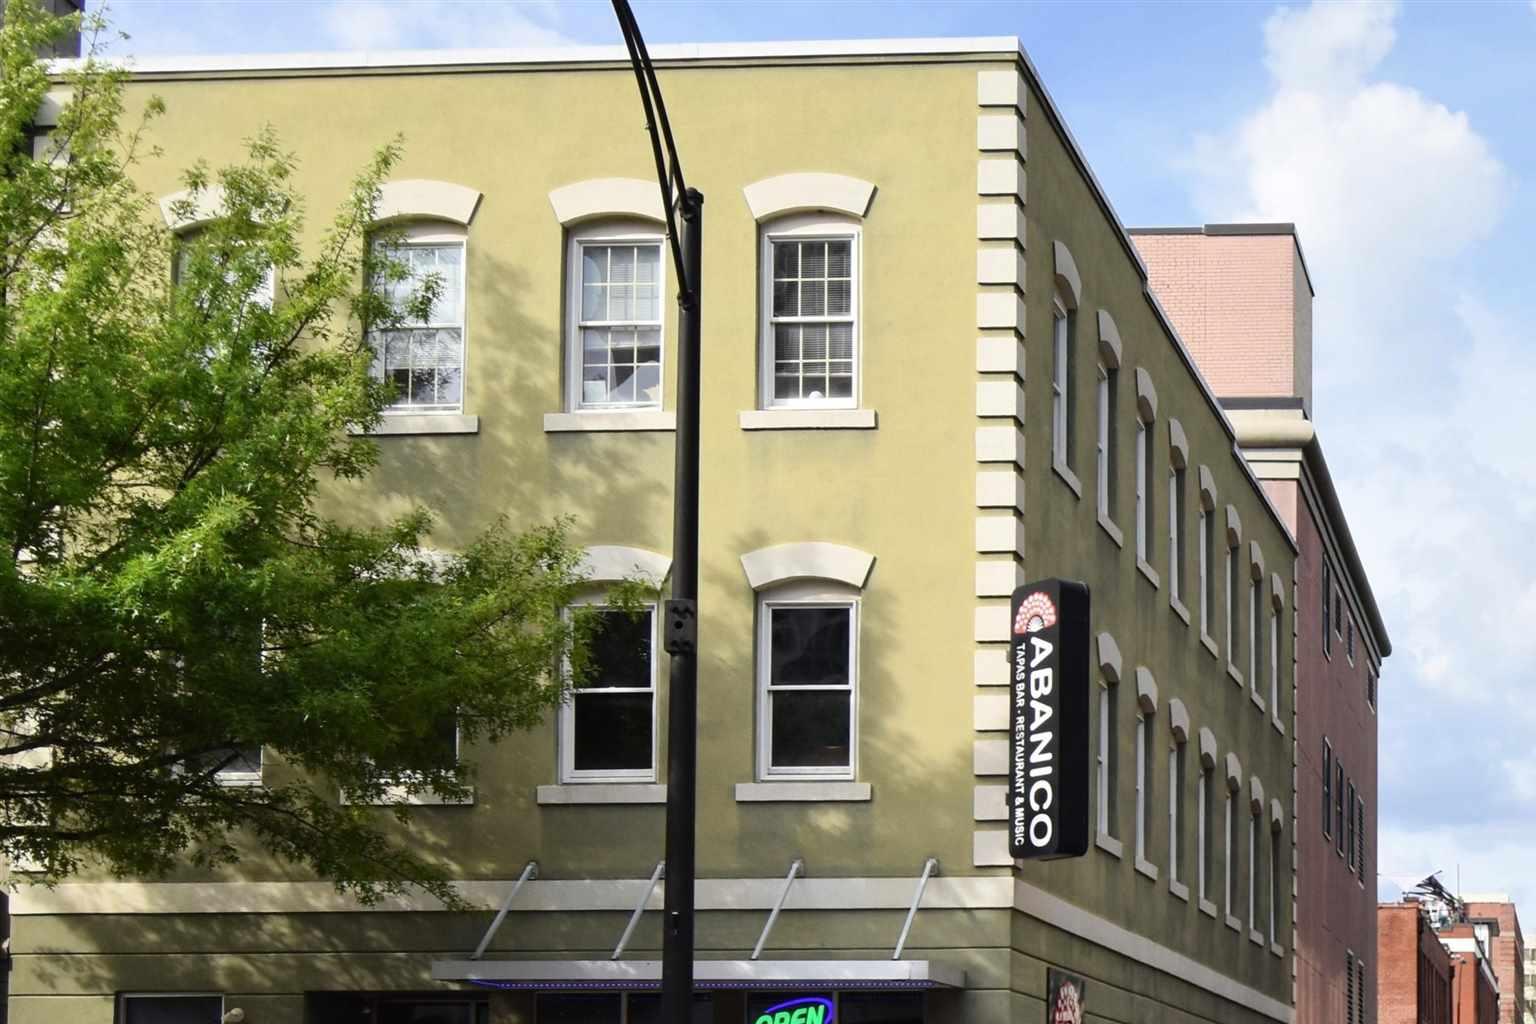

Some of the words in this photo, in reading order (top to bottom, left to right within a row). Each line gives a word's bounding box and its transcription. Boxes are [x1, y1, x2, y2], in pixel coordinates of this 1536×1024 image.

[1015, 643, 1026, 681] TAPAS
[1015, 682, 1026, 708] BAR
[1014, 715, 1025, 794] RESTAURANT
[1030, 636, 1054, 848] ABANICO
[1014, 796, 1025, 807] &
[1014, 807, 1025, 846] MUSIC
